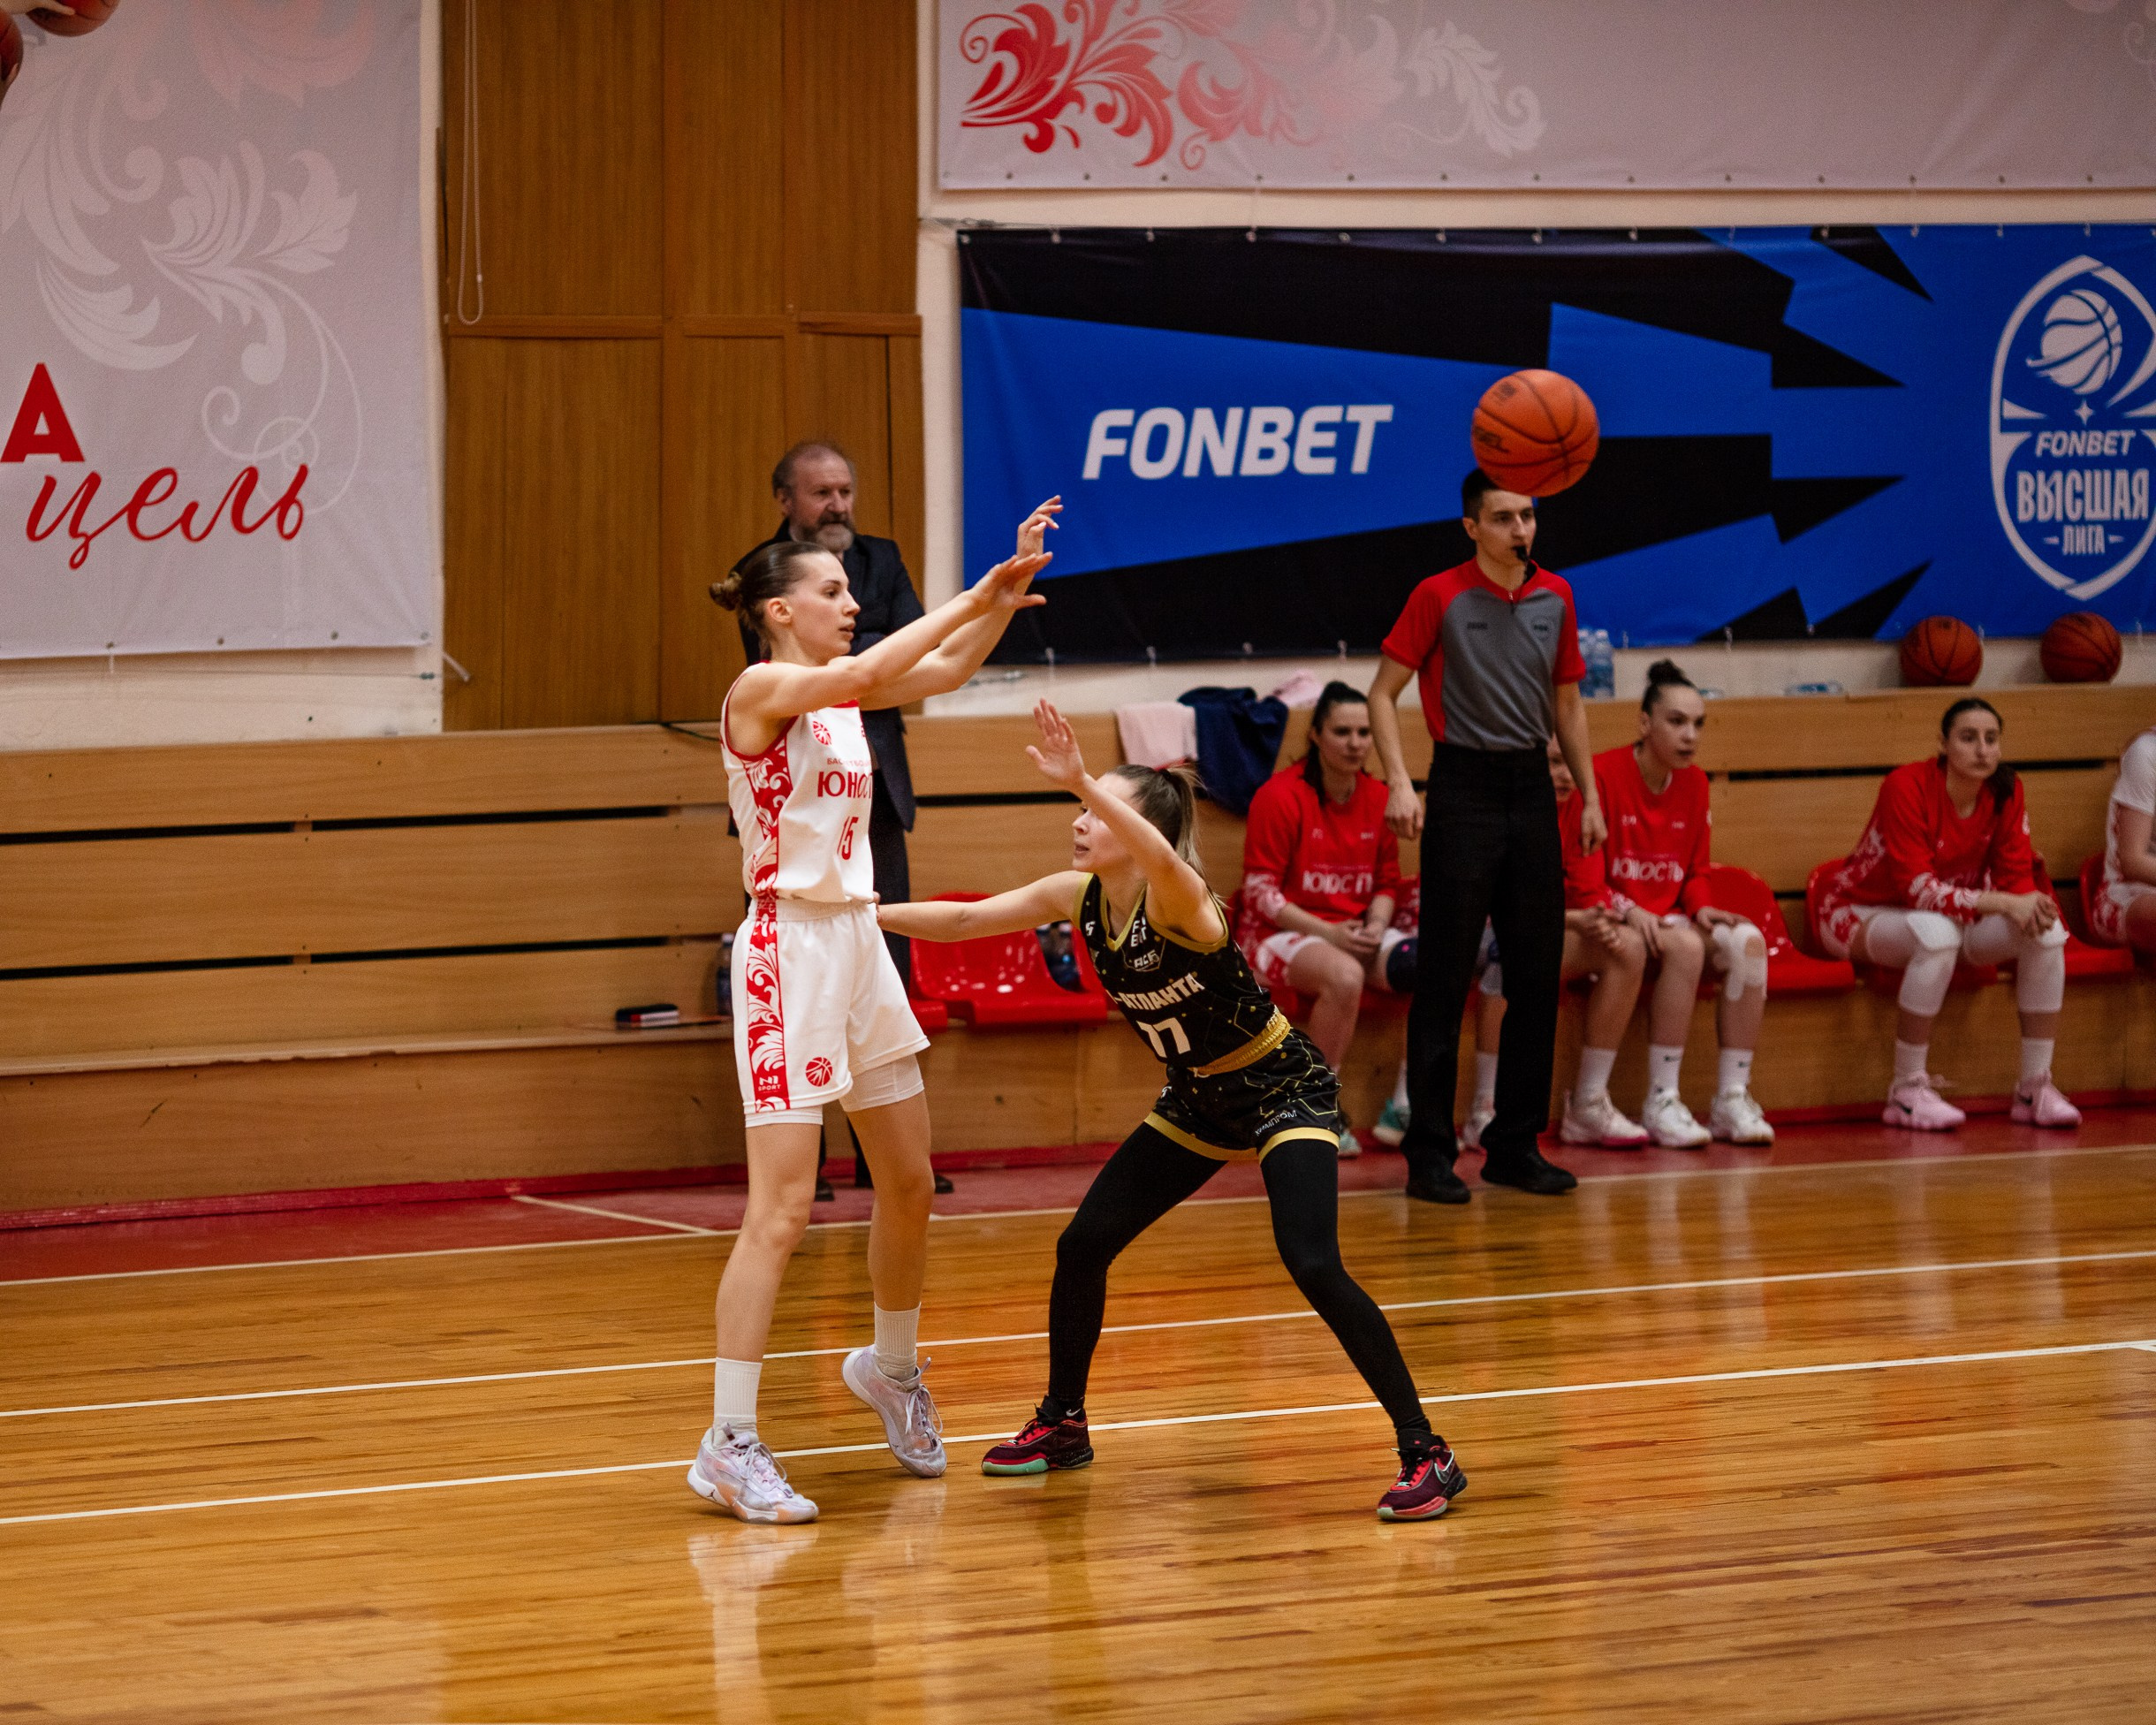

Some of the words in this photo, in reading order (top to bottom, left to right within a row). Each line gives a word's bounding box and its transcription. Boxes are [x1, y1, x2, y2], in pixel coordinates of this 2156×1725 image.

[1082, 404, 1394, 480] FONBET
[2035, 429, 2137, 458] FONBET
[26, 463, 308, 570] цель
[2016, 468, 2150, 523] ВЫСШАЯ
[2061, 524, 2106, 556] ЛИГА
[837, 816, 859, 861] 15
[757, 1083, 781, 1092] SPORT
